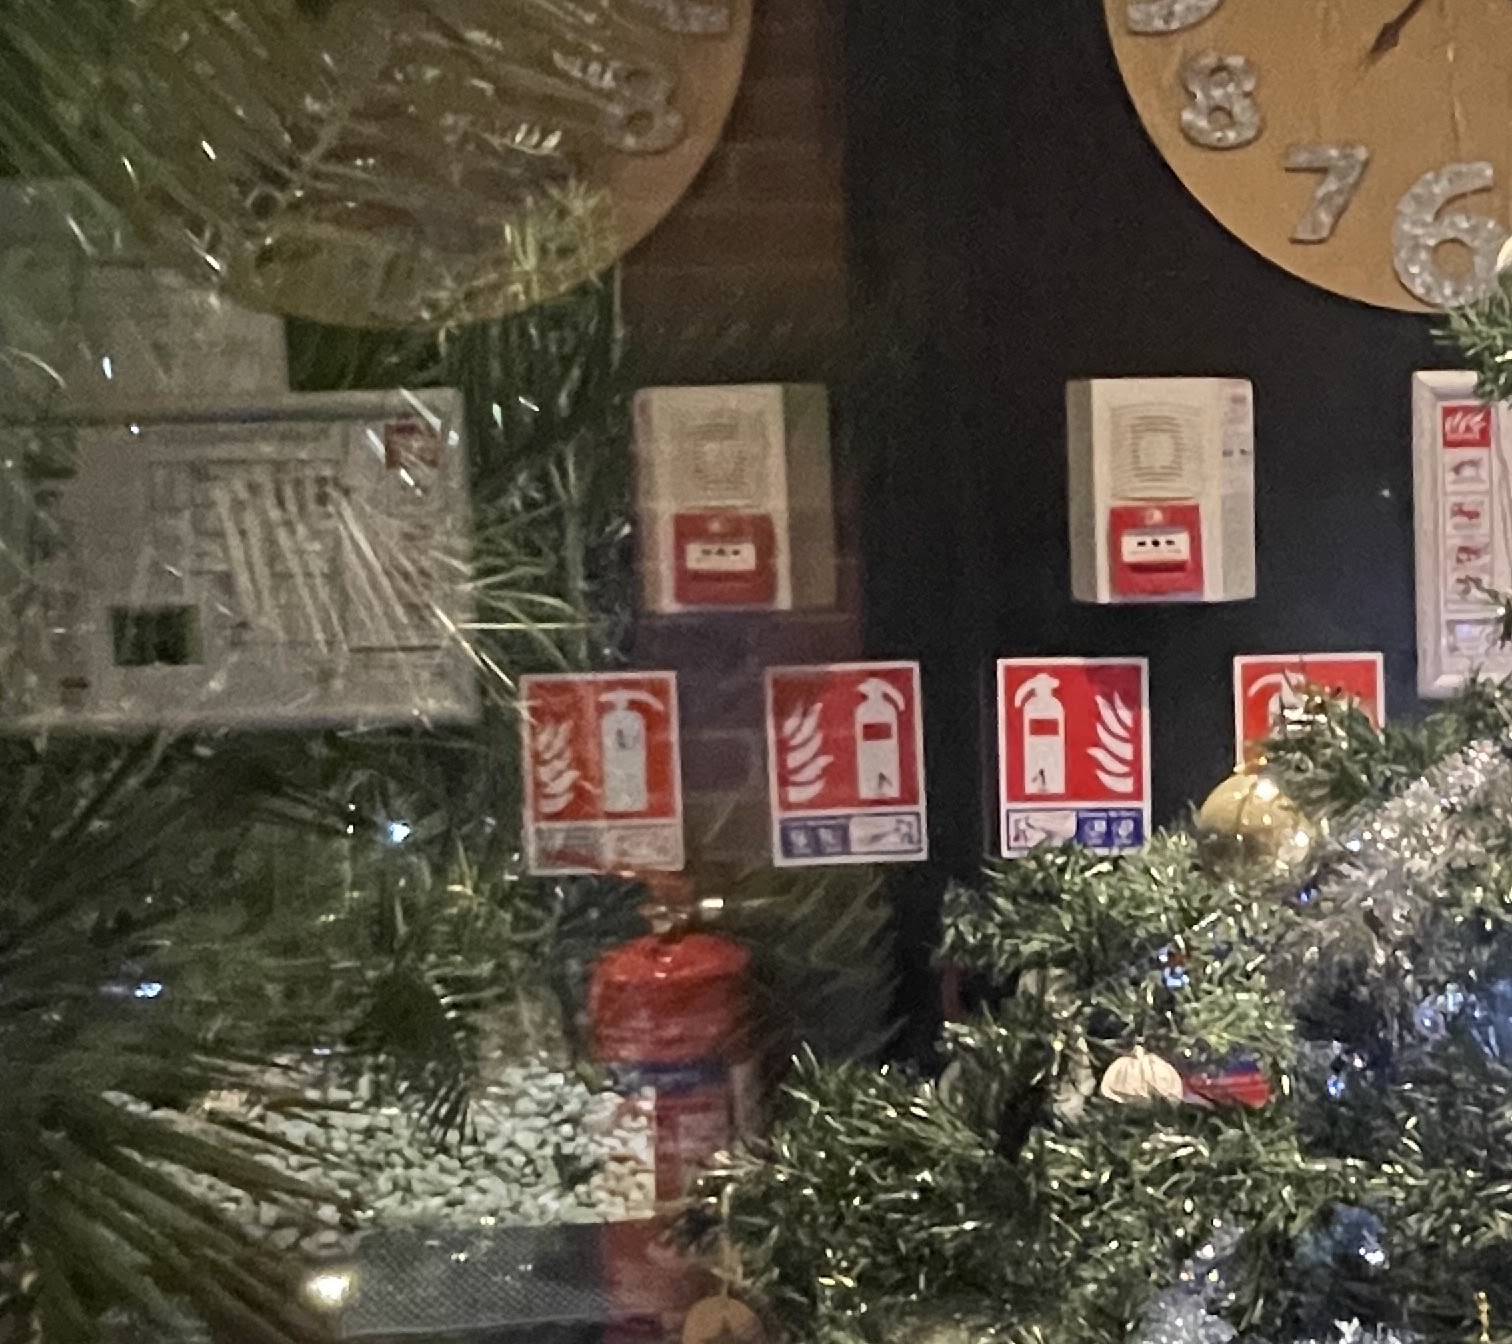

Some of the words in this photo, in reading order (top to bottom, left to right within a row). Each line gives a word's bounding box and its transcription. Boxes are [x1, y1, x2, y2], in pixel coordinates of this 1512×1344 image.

[1179, 55, 1264, 151] 8
[1285, 145, 1369, 245] 7
[1392, 160, 1501, 309] 6
